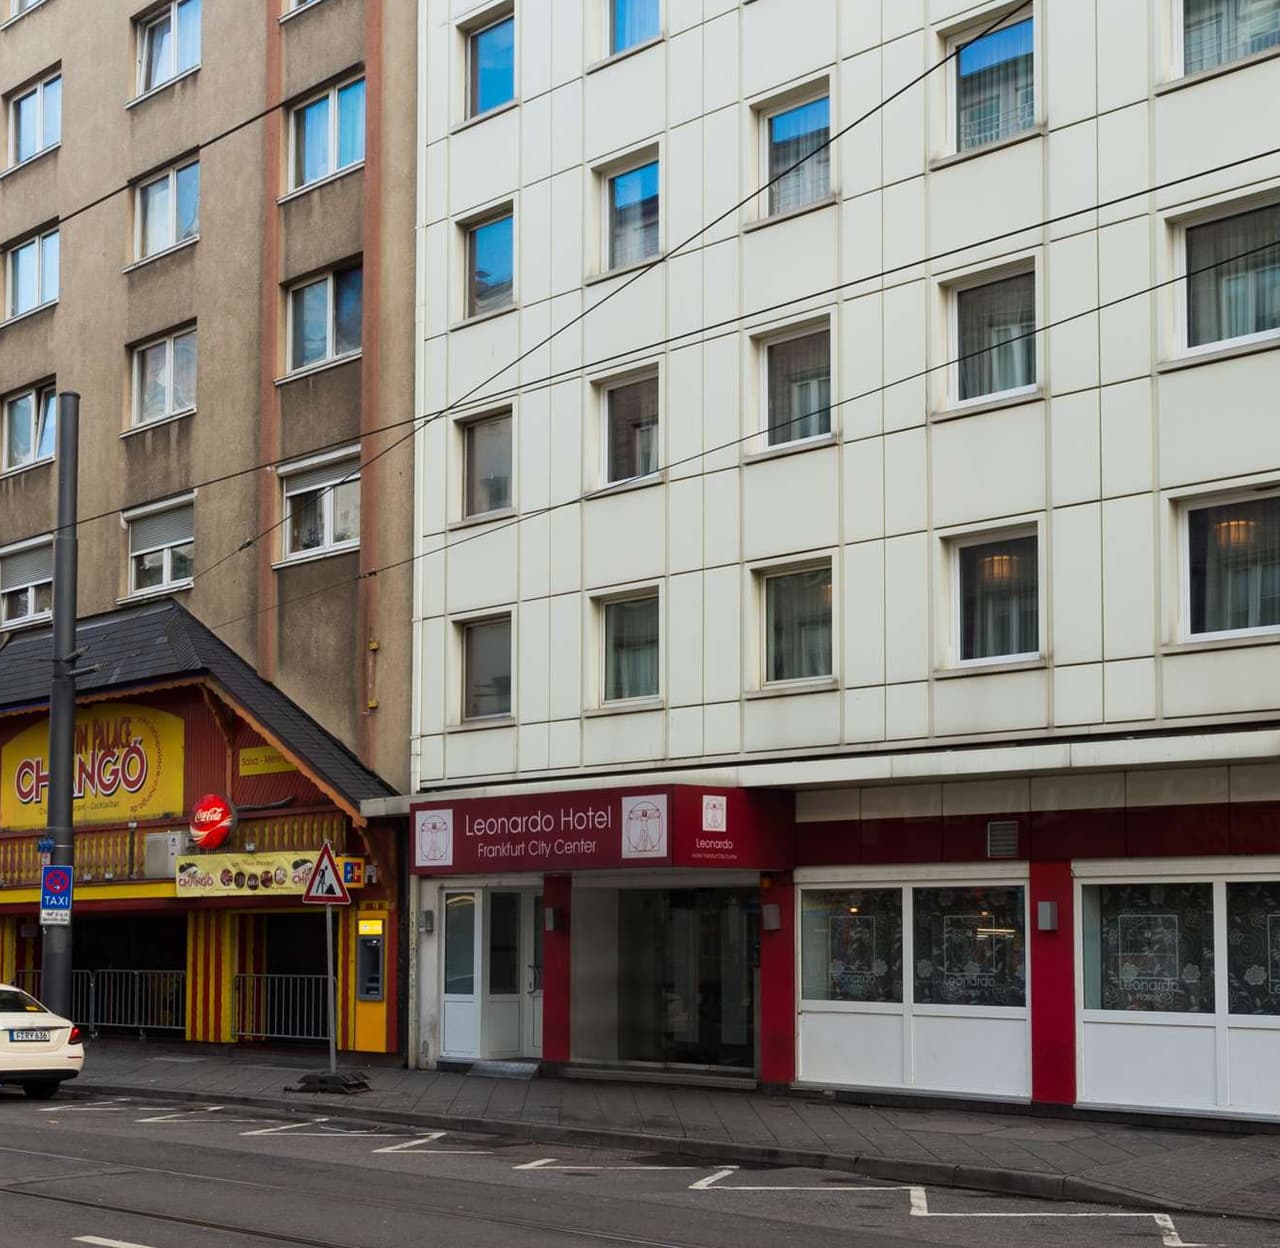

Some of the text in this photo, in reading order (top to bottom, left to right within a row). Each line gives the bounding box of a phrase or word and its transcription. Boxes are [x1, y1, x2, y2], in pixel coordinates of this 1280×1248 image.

[195, 807, 224, 822] Coca-Cola
[465, 806, 612, 837] Leonardo Hotel
[477, 838, 597, 858] Frankfurt City Center
[695, 837, 734, 850] Leonardo
[44, 895, 69, 906] TAXI
[1119, 978, 1179, 991] Leonardo
